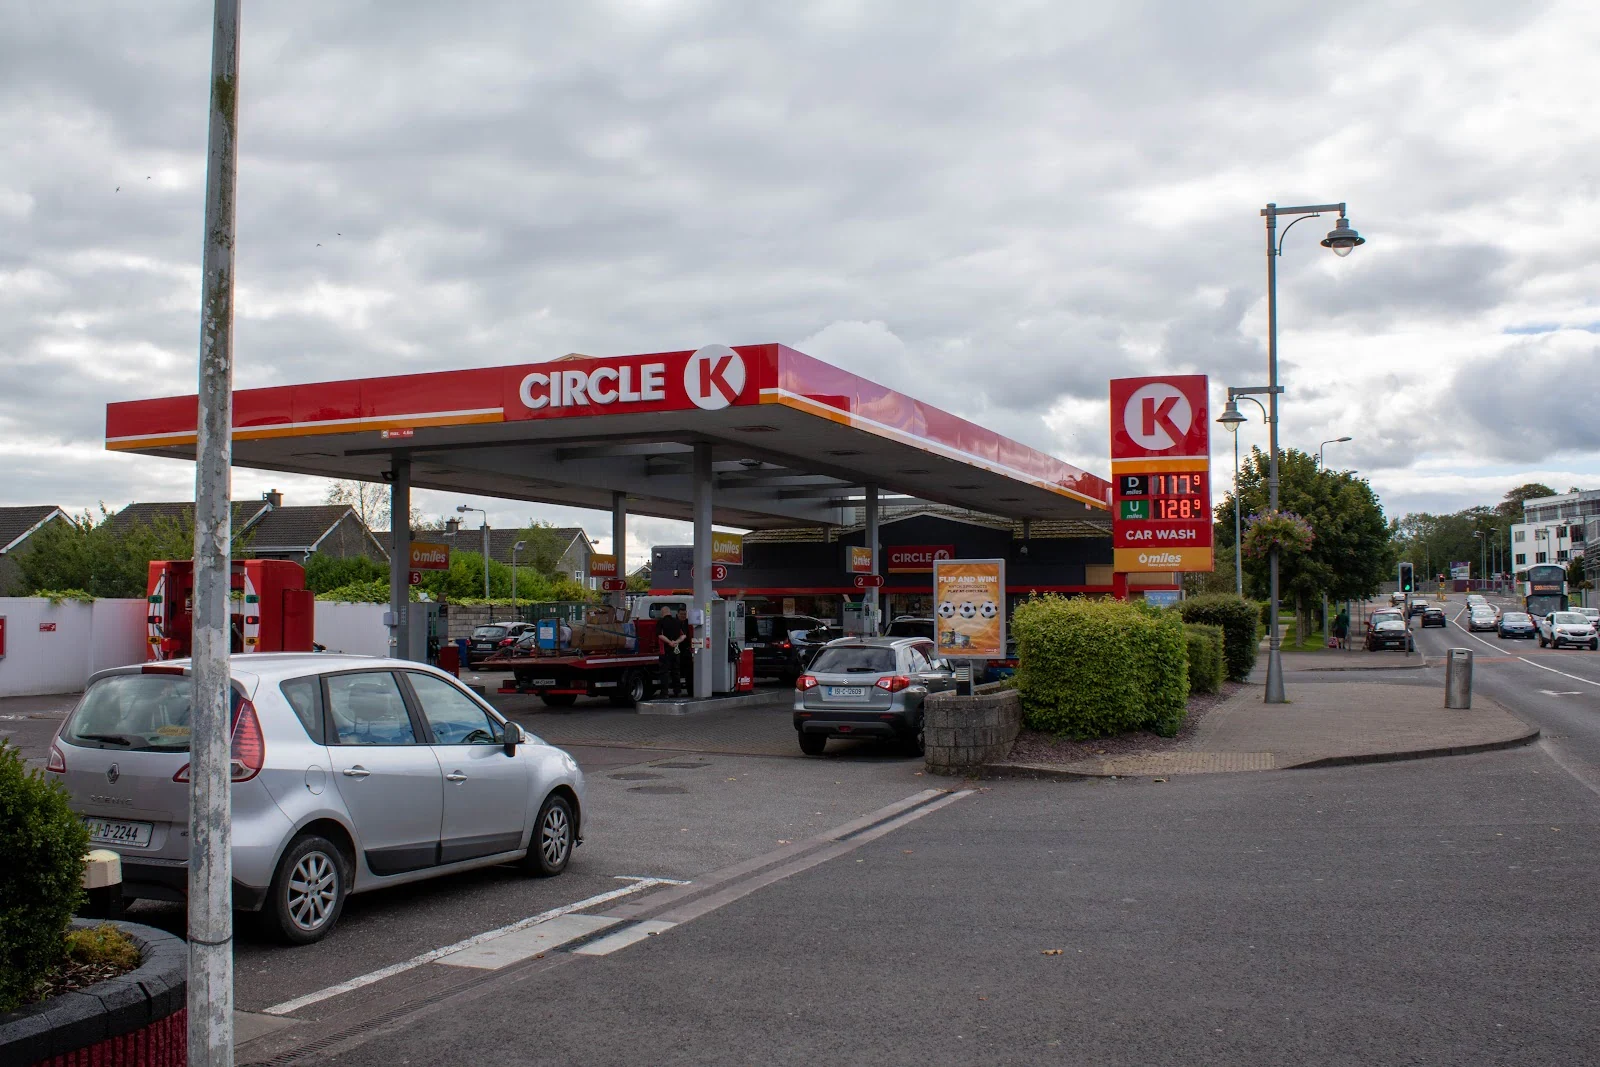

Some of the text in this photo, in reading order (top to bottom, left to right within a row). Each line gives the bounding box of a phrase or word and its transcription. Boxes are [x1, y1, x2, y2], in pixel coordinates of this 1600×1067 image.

[519, 355, 739, 409] CIRCLE K
[1142, 396, 1187, 445] K
[1127, 476, 1139, 488] D
[1129, 500, 1139, 512] U
[1125, 529, 1196, 540] CAR WASH
[720, 540, 740, 555] miles
[420, 550, 446, 563] miles
[891, 552, 932, 563] CIRCLE
[1147, 553, 1182, 564] miles
[412, 573, 419, 583] 5
[716, 567, 724, 579] 3
[604, 581, 624, 590] 8 7
[857, 577, 880, 586] 2 1
